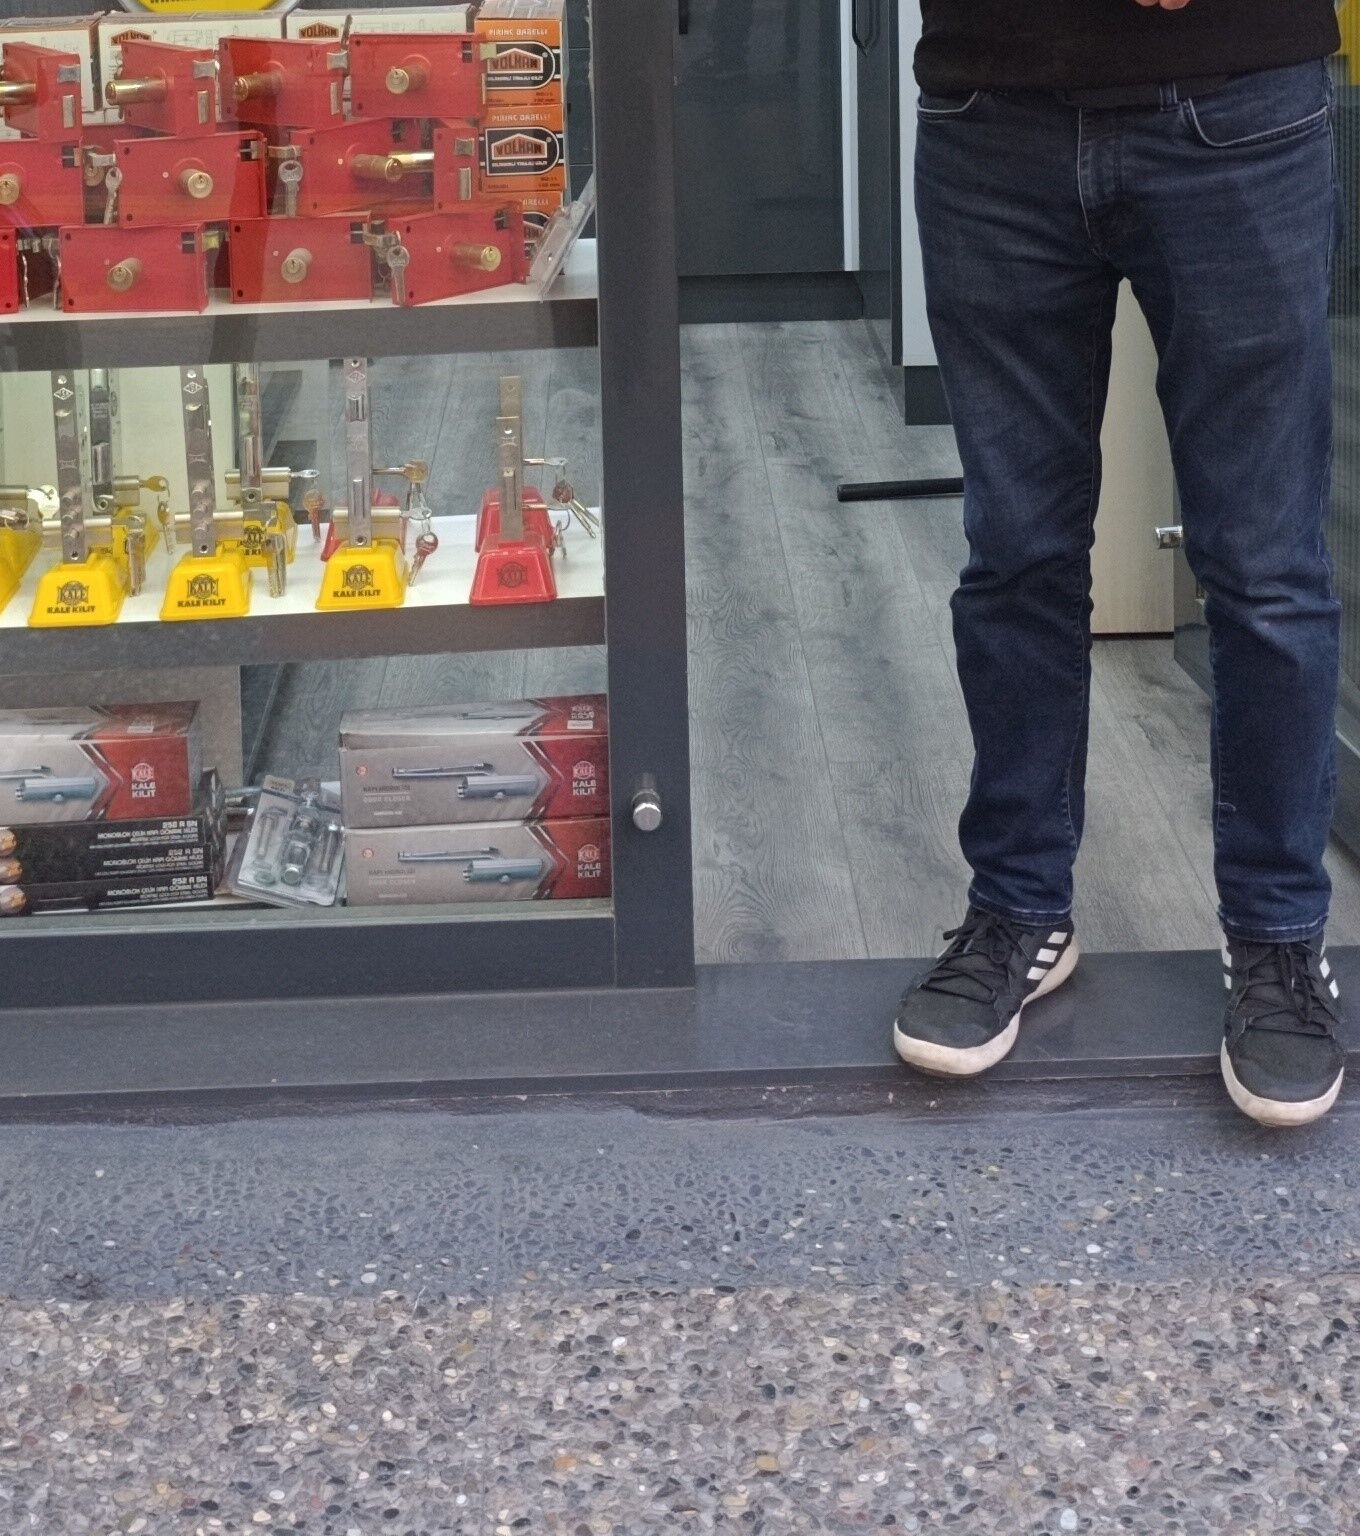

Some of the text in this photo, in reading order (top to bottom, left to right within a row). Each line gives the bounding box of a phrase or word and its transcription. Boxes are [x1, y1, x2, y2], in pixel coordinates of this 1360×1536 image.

[332, 589, 357, 597] KALE
[177, 600, 201, 608] KALE
[46, 606, 70, 614] KALE
[131, 782, 155, 790] KALE
[572, 780, 597, 789] KALE
[577, 863, 601, 871] KALE
